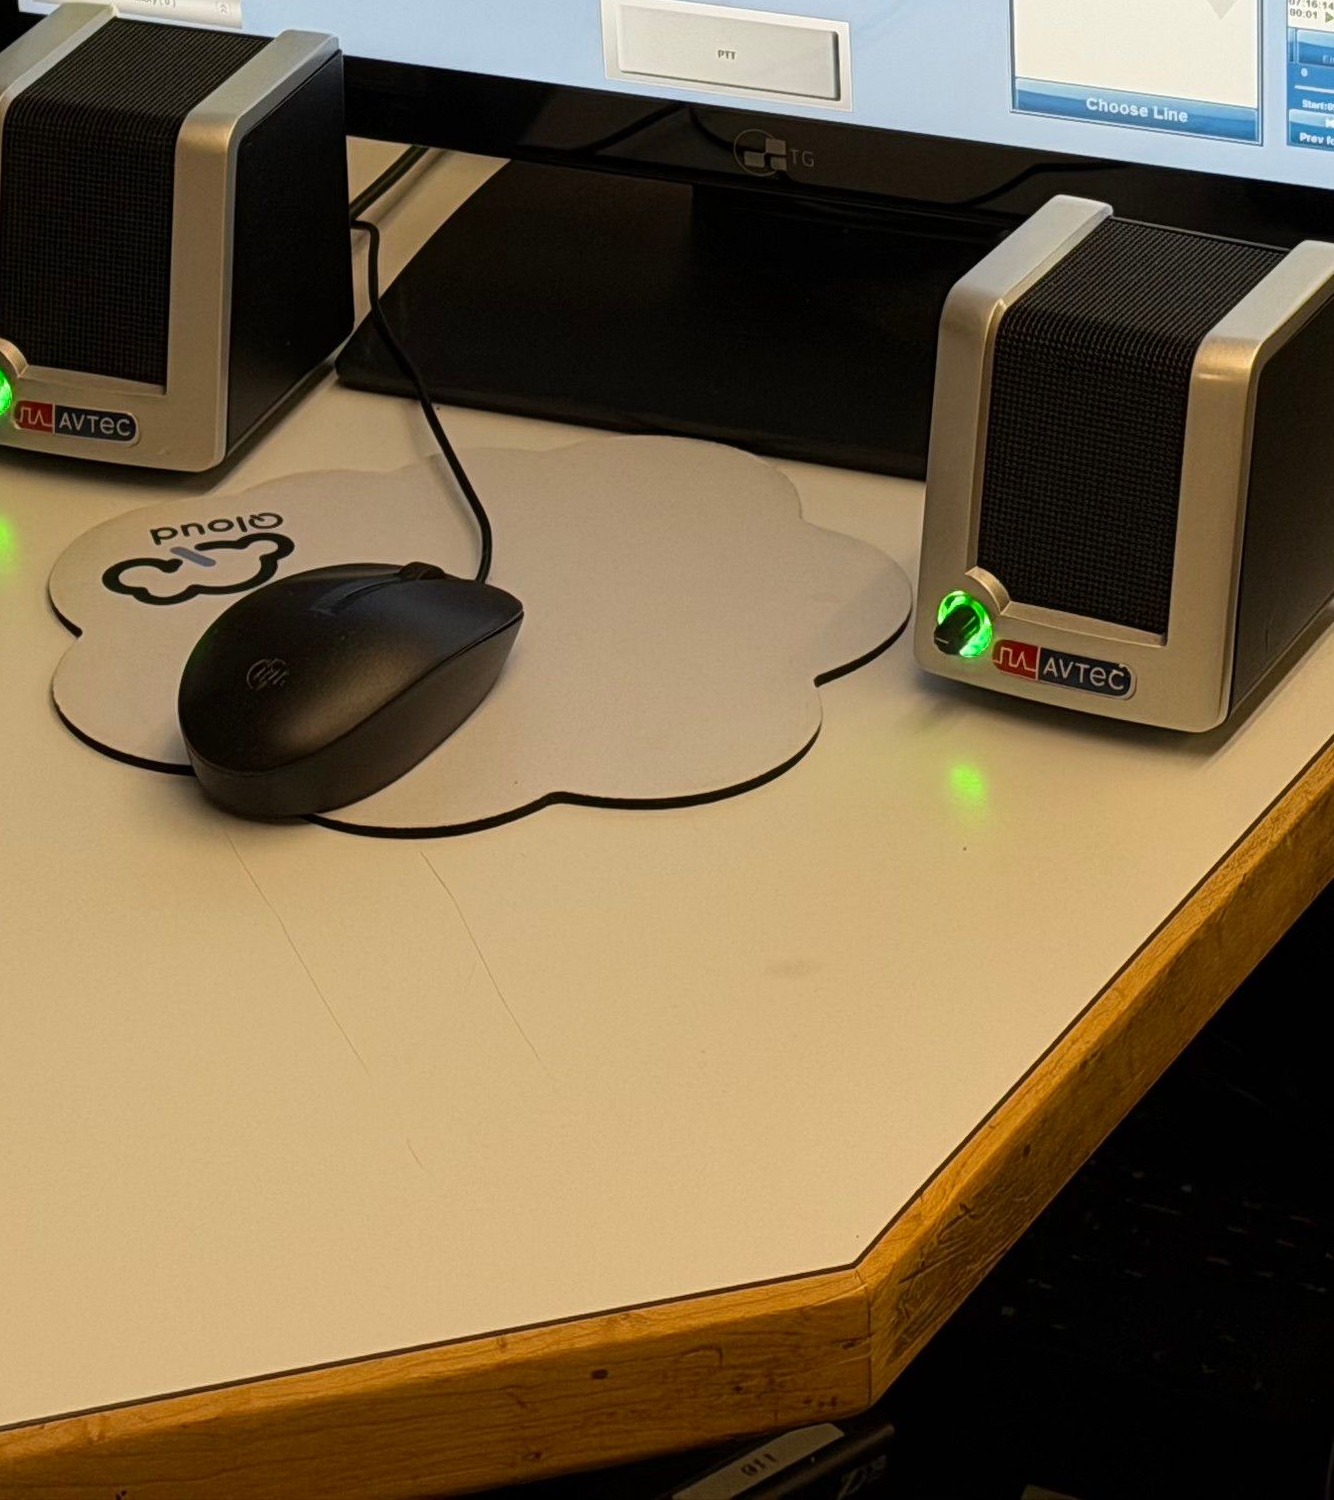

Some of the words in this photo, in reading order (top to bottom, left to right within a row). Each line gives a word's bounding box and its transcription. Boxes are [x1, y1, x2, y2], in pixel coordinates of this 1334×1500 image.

[717, 49, 737, 61] PTT
[1085, 96, 1149, 117] Choose
[1152, 105, 1189, 124] Line
[1299, 132, 1324, 145] Prev
